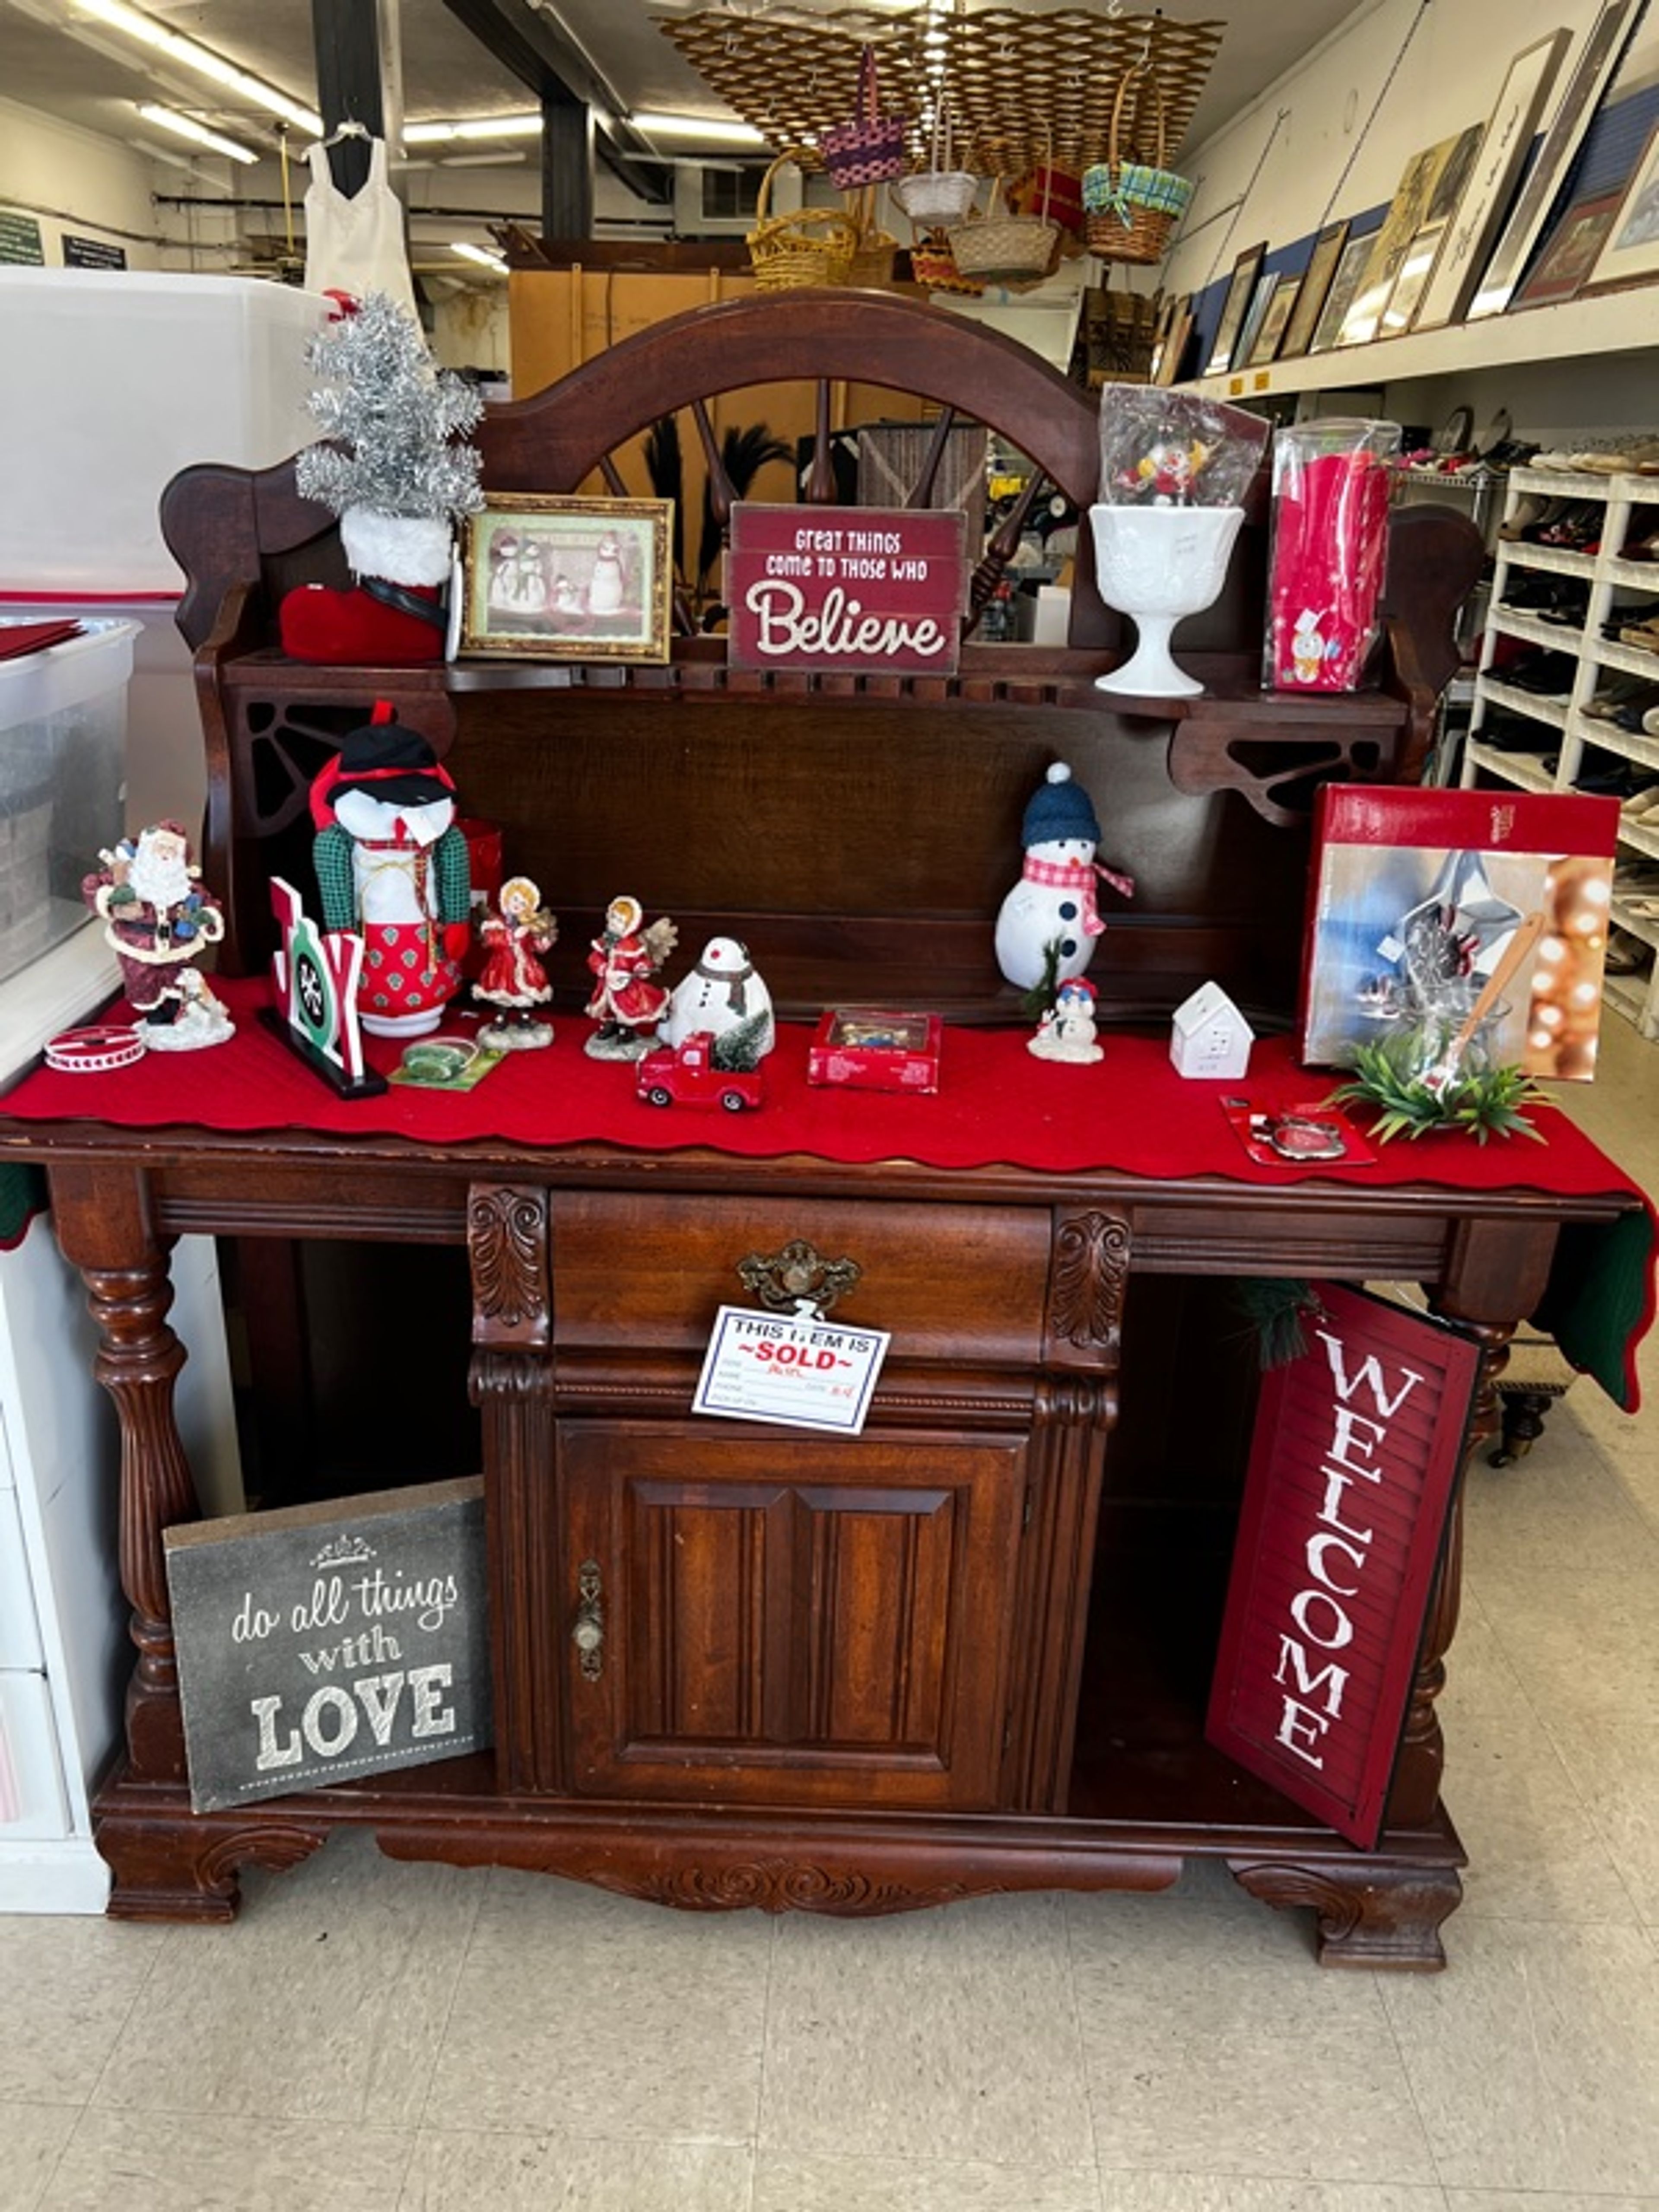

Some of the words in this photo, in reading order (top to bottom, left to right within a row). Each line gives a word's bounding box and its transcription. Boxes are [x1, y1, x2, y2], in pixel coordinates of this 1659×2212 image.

[891, 560, 928, 581] WHO
[745, 579, 946, 656] Believe
[734, 1319, 783, 1339] THIS
[849, 1338, 870, 1353] IS
[1271, 1329, 1424, 1770] WELCOME
[232, 1592, 280, 1643] do
[292, 1576, 350, 1632] all
[351, 1568, 458, 1632] things
[298, 1624, 403, 1675] with
[251, 1663, 455, 1770] LOVE
